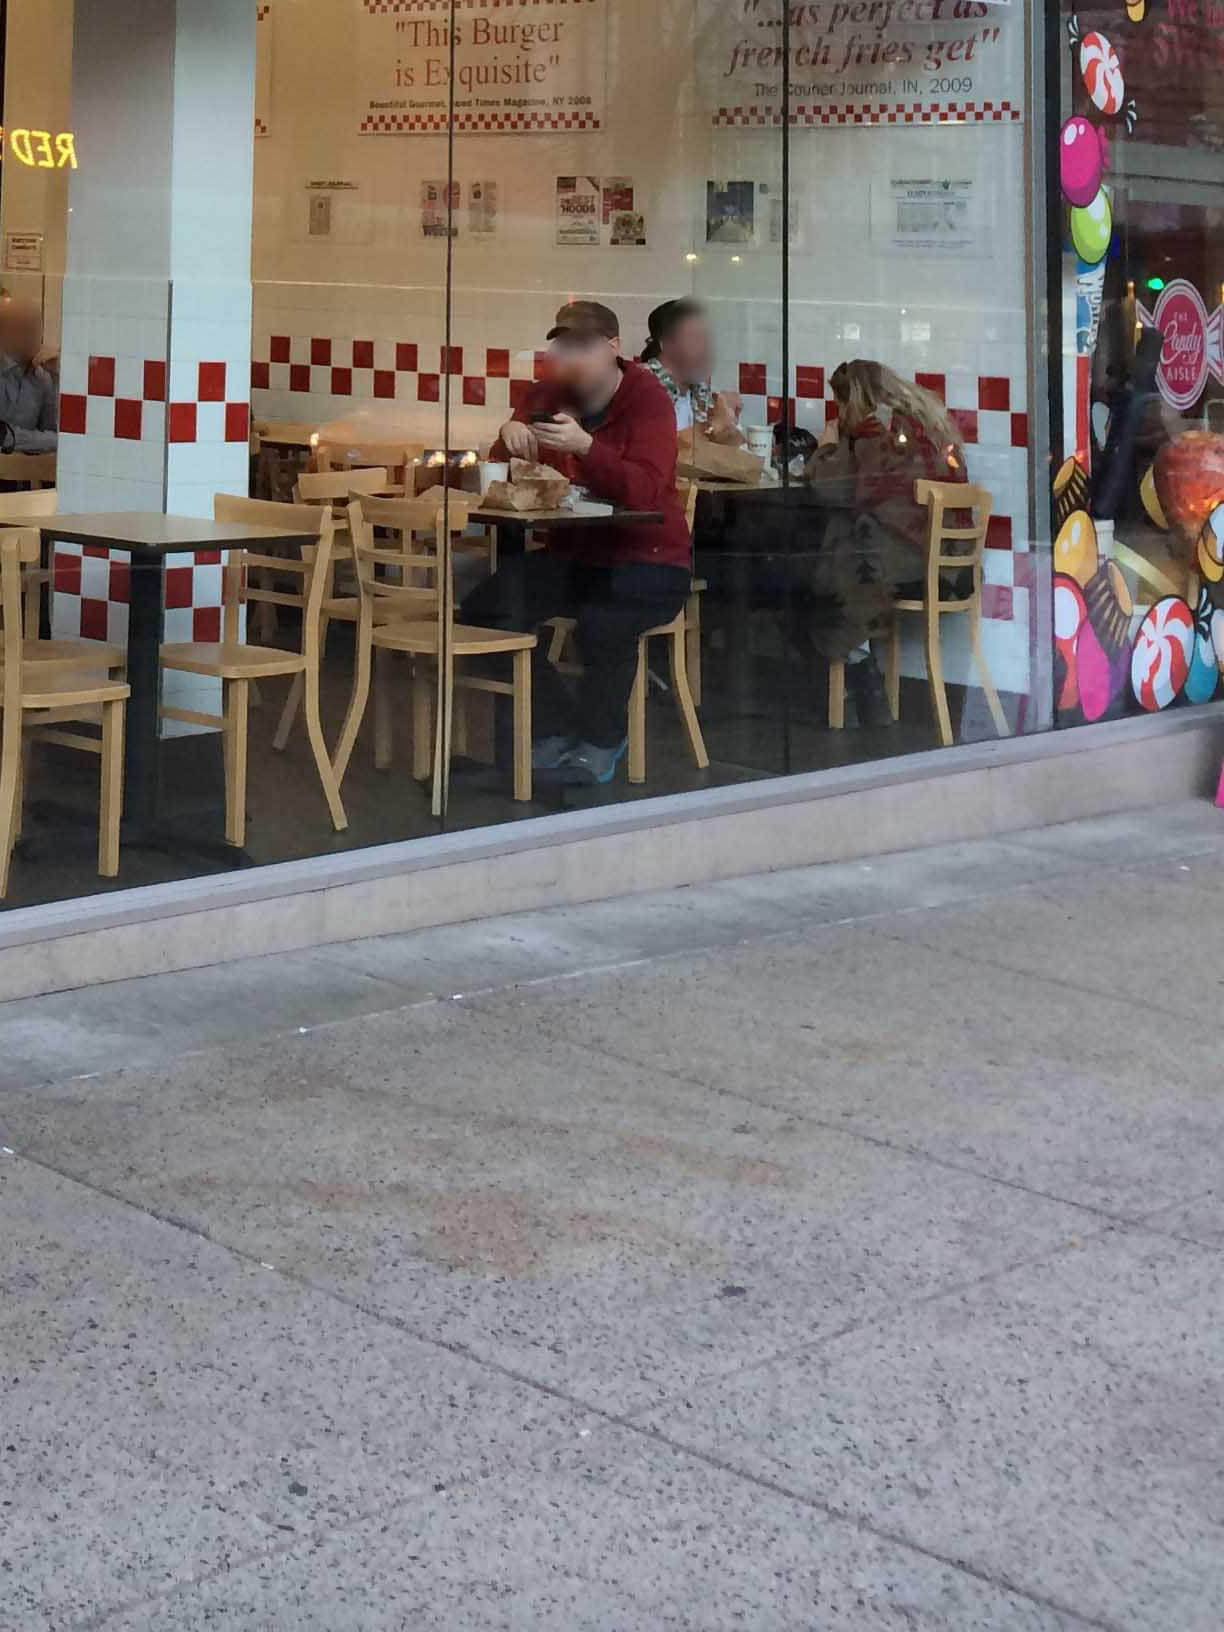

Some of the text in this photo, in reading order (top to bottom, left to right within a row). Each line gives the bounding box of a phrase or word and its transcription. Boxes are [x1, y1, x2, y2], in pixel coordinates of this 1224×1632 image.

[471, 17, 565, 52] Burger
[836, 33, 916, 74] fries
[395, 59, 415, 87] is
[754, 82, 777, 97] The
[929, 77, 973, 95] 2009
[1160, 320, 1202, 365] Candy
